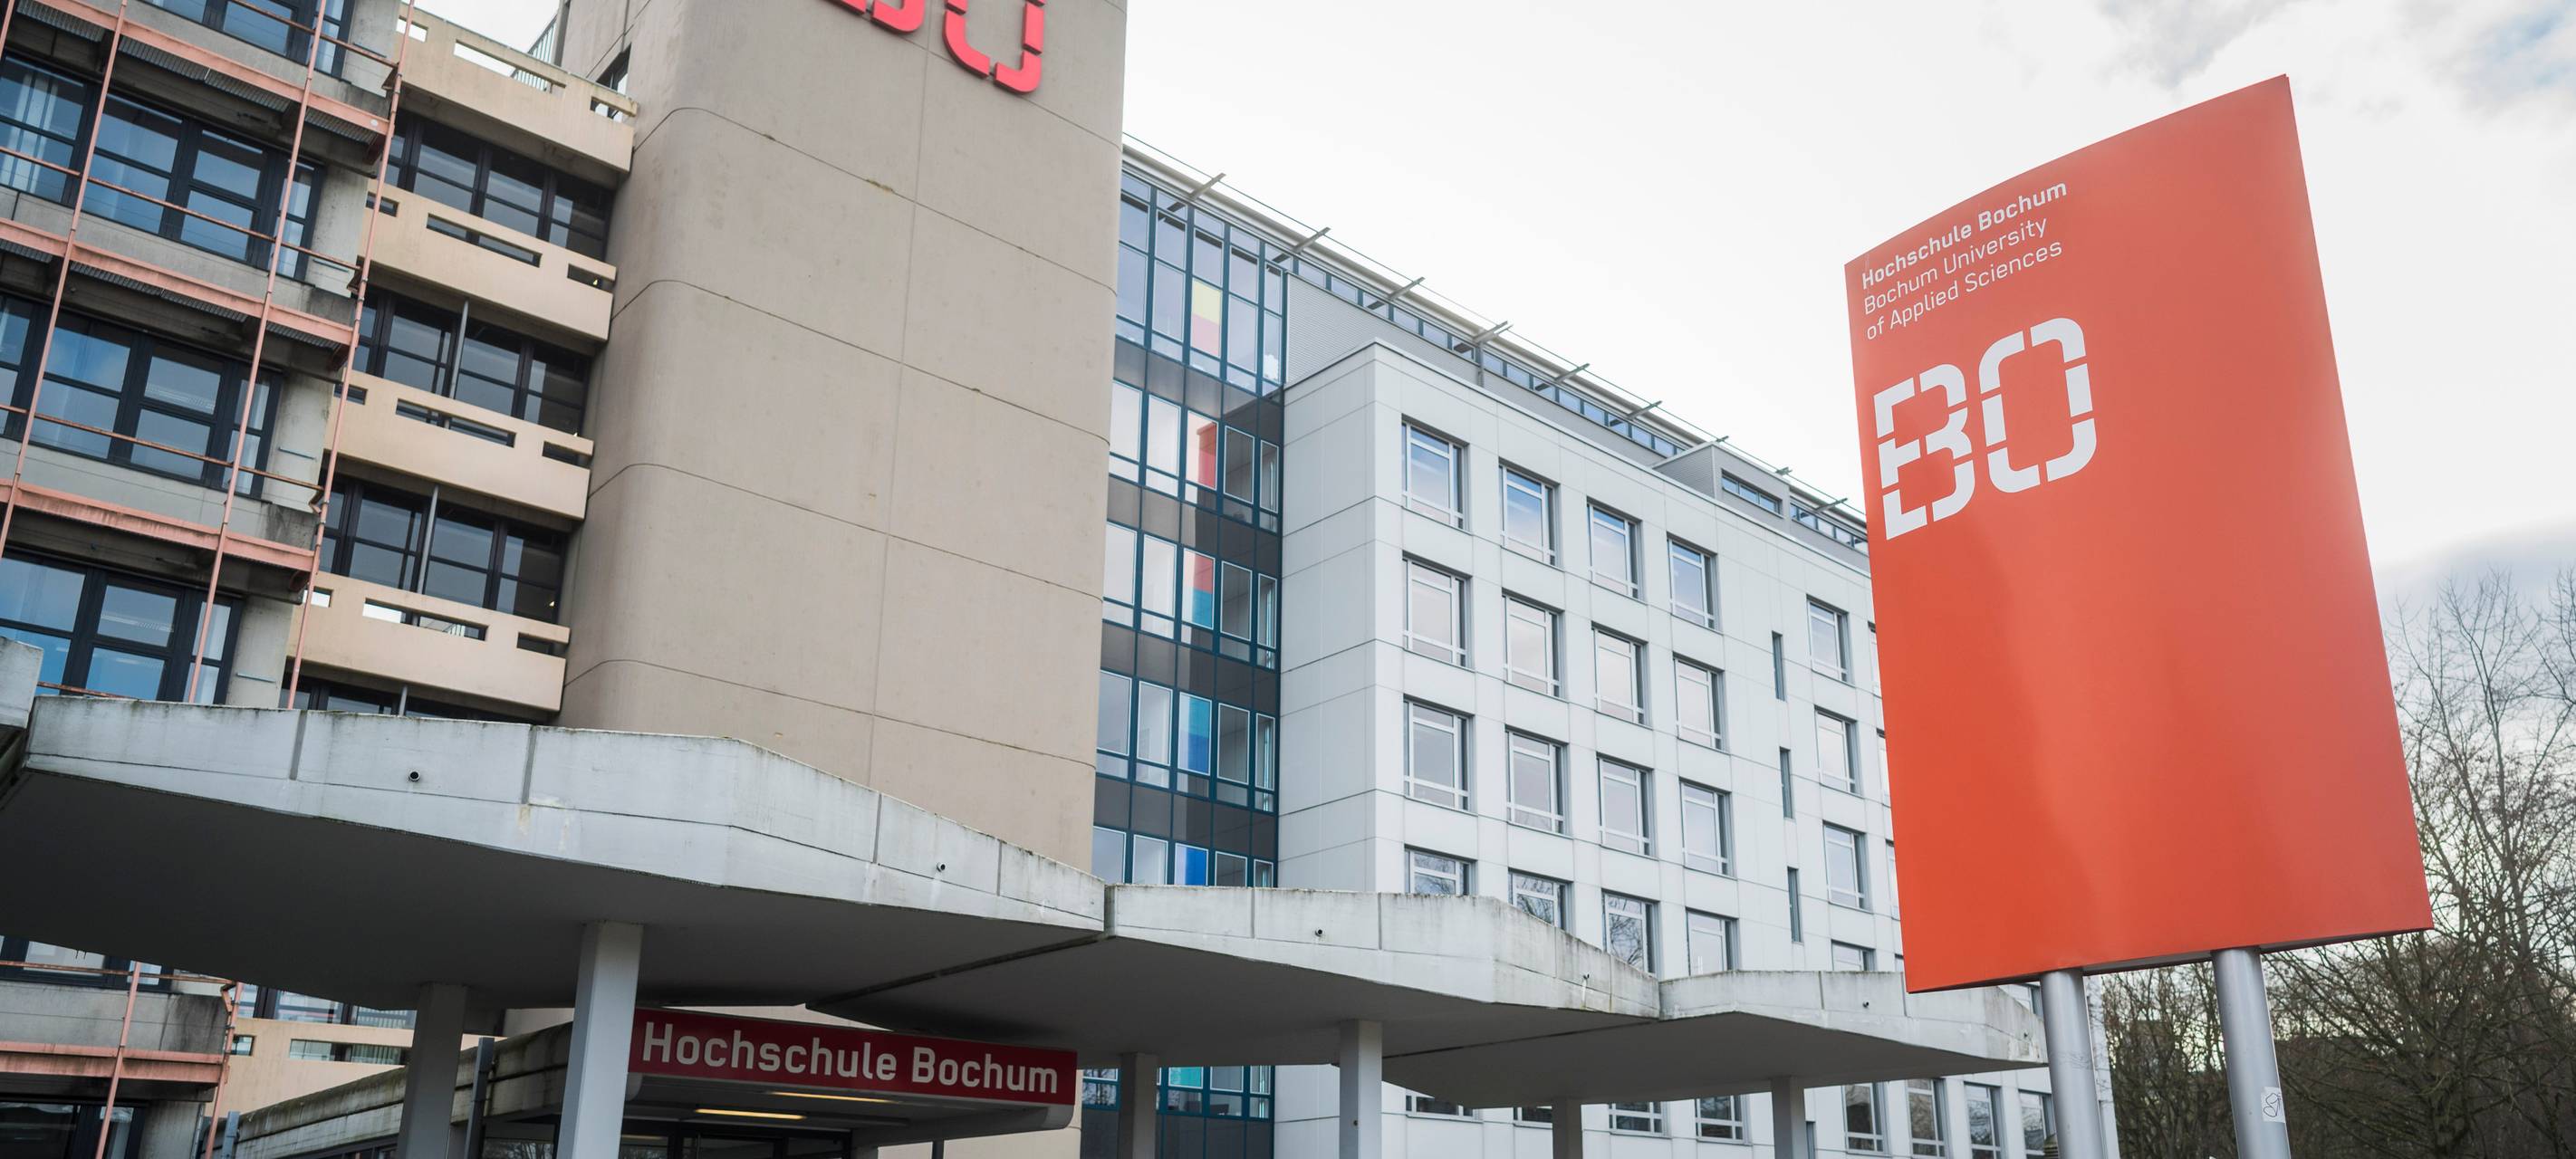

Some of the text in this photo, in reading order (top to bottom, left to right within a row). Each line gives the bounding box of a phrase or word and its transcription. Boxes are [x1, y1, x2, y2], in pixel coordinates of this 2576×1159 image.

[1861, 182, 2067, 290] Hochschule Bochum
[1863, 218, 2047, 315] Bochum University
[1867, 241, 2062, 340] of Applied Sciences
[1873, 317, 2098, 541] BO
[642, 1021, 1058, 1094] Hochschule Bochum
